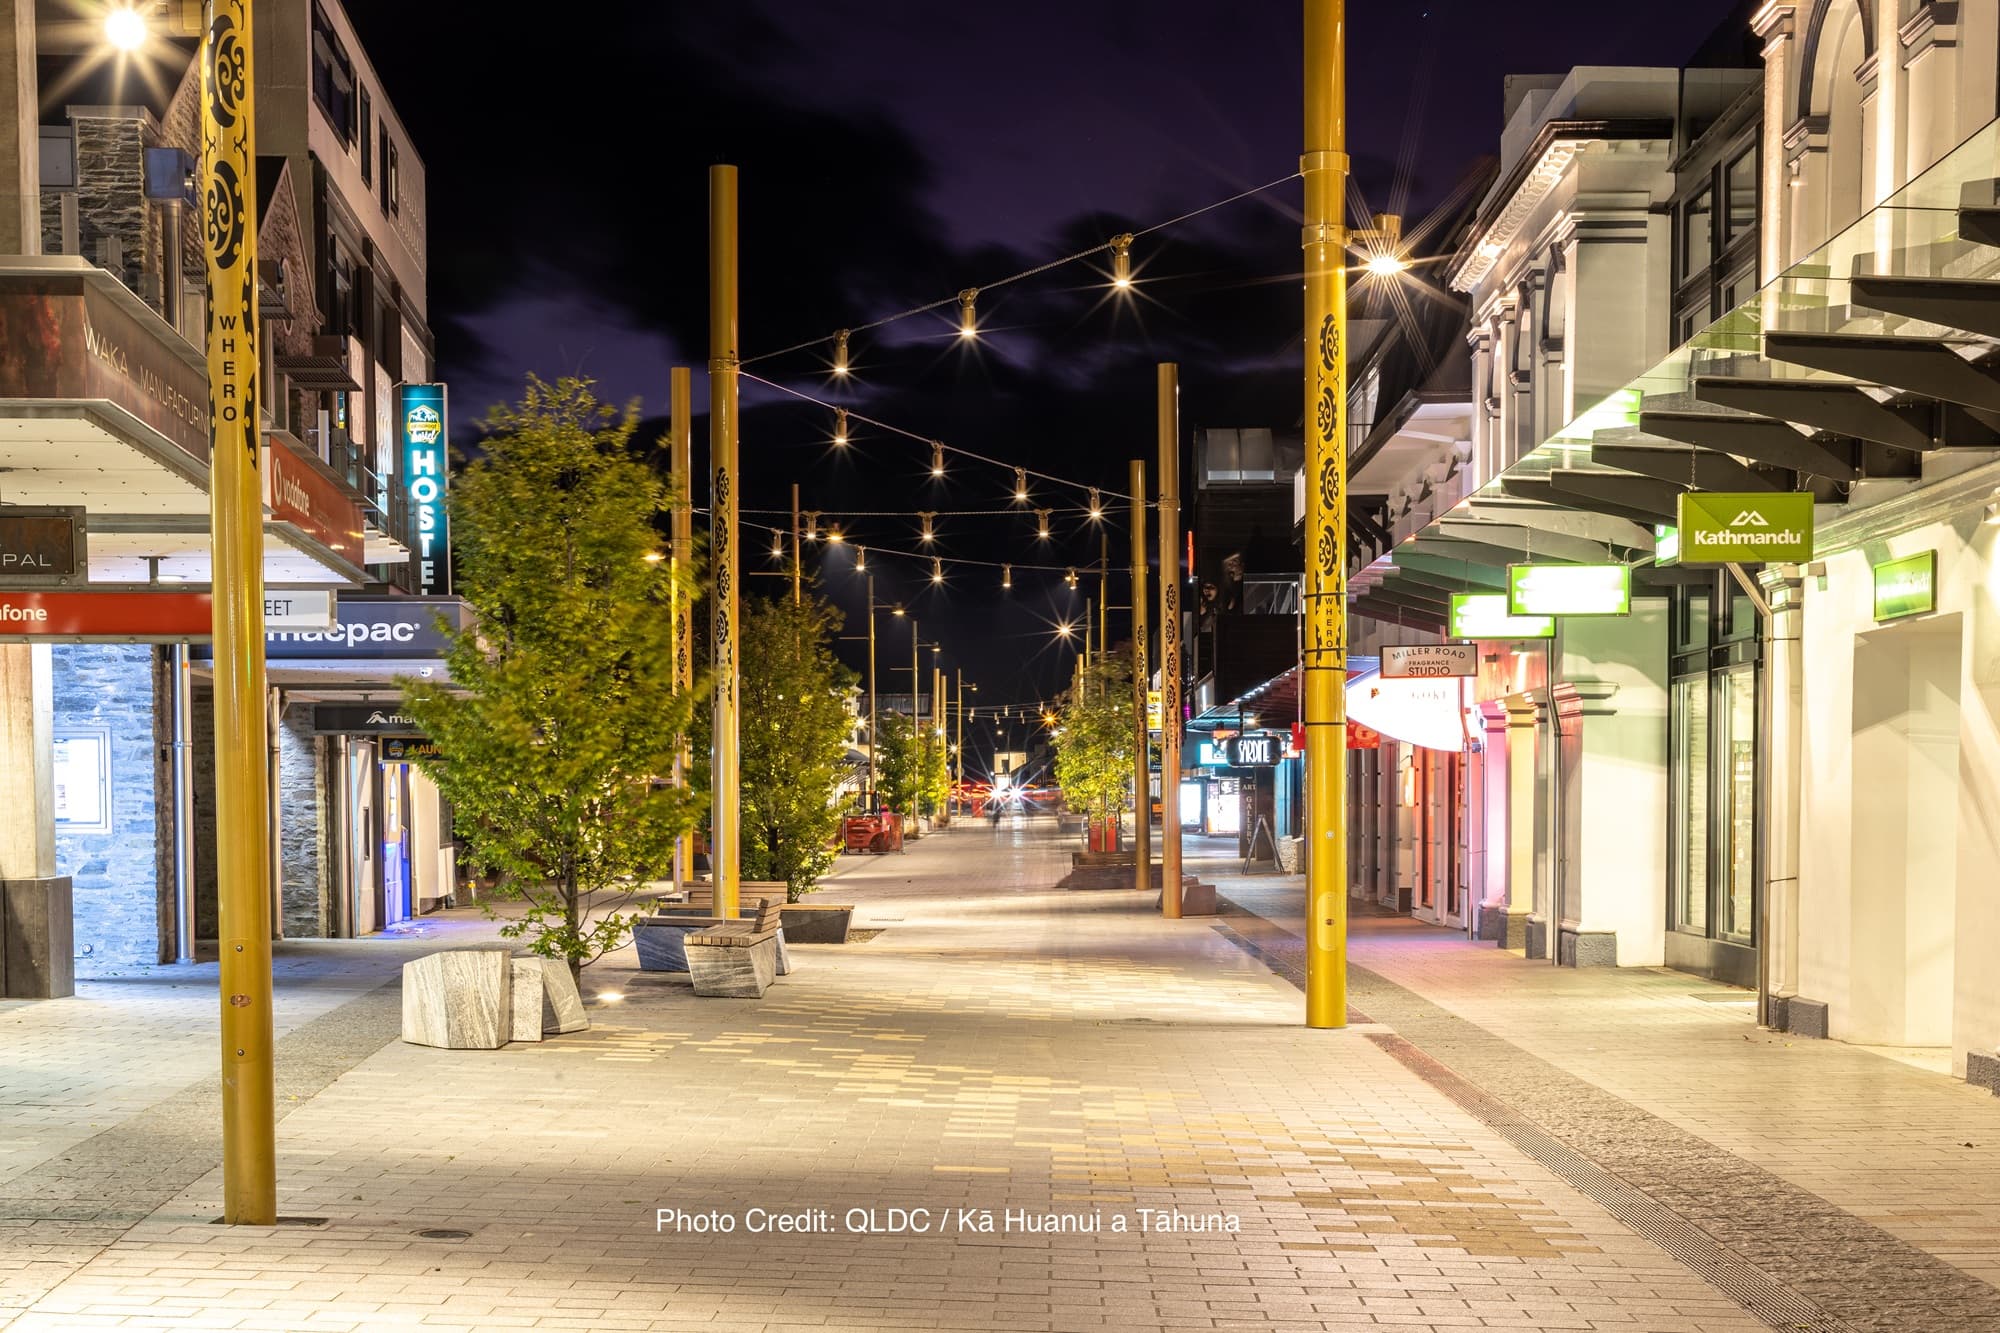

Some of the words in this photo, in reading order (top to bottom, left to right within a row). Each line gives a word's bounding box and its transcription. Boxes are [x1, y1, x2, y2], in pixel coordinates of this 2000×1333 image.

[219, 315, 237, 421] WHERO
[83, 322, 129, 380] WAKA
[139, 364, 209, 437] MANUFACTURIN
[1694, 528, 1801, 545] Kathmandu
[0, 604, 48, 621] fone
[1325, 597, 1334, 648] WHERO
[1392, 647, 1430, 660] MILLER
[1435, 647, 1466, 659] ROAD
[1408, 666, 1451, 676] STUDIO
[411, 744, 445, 754] LAUN
